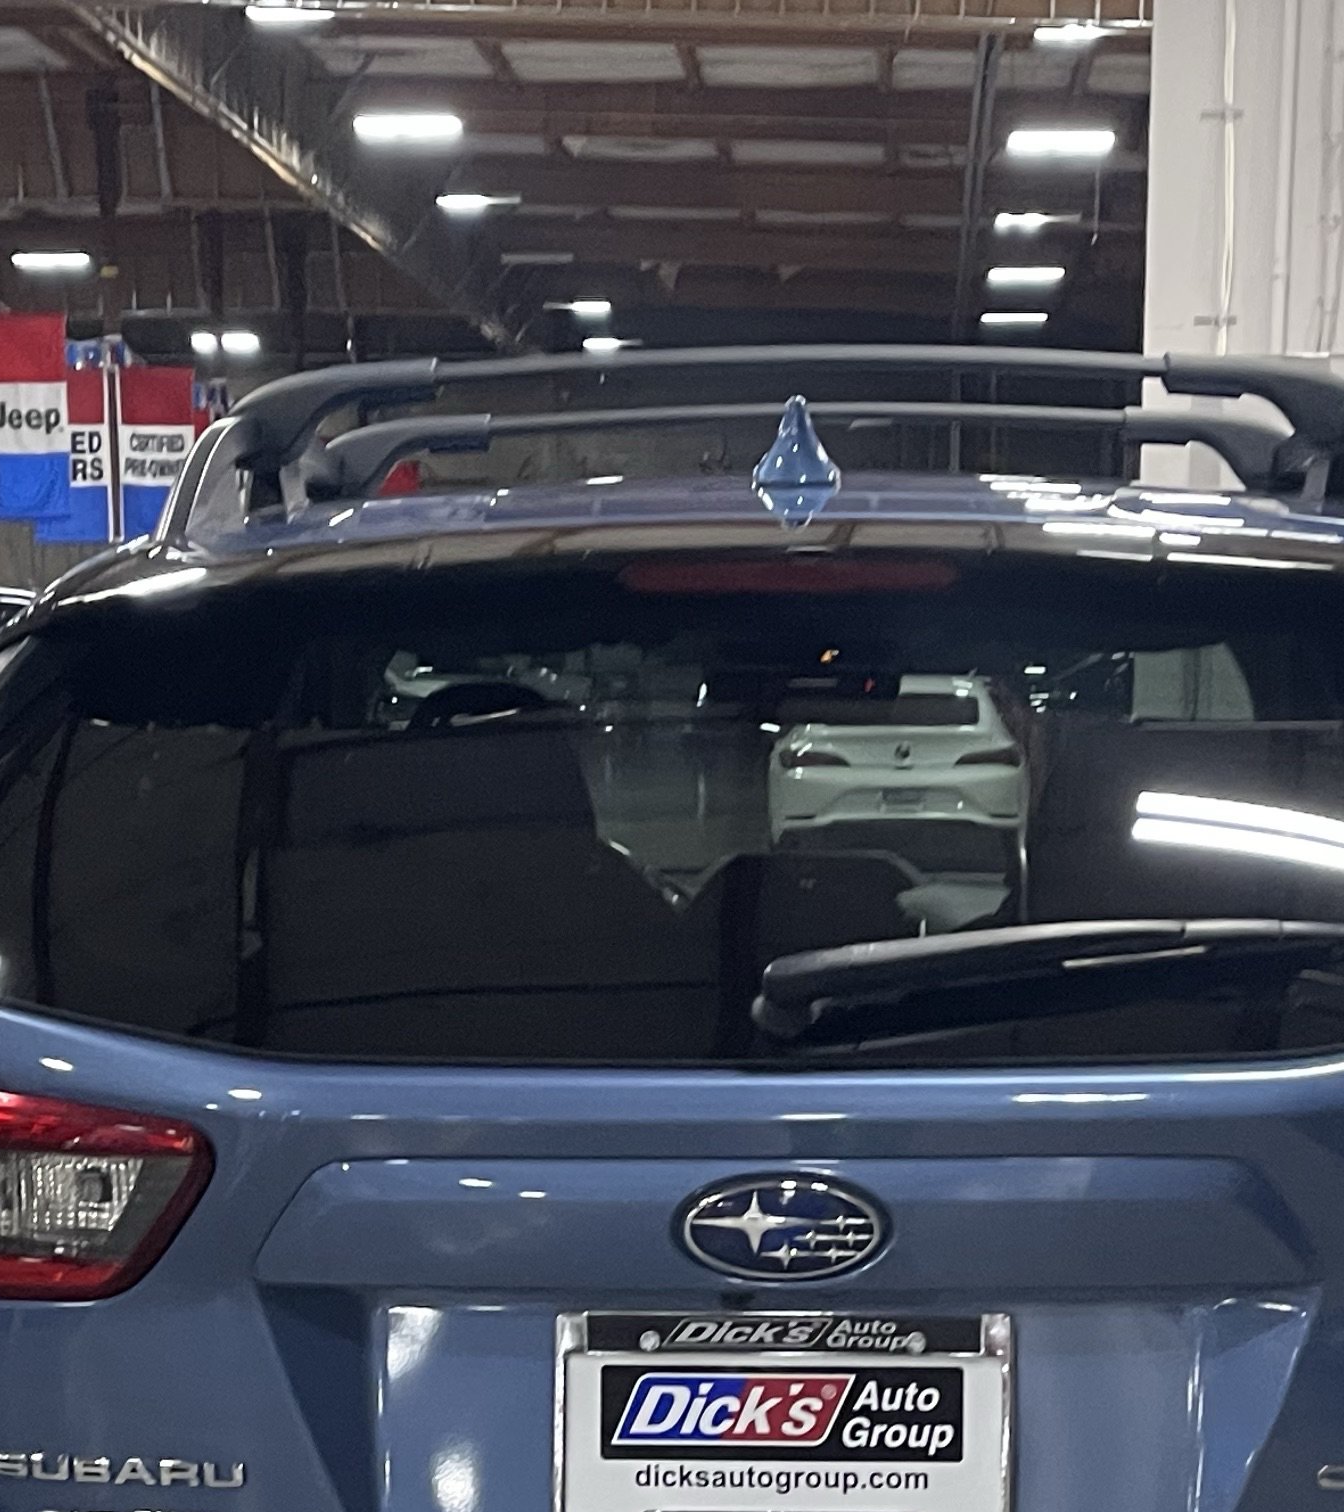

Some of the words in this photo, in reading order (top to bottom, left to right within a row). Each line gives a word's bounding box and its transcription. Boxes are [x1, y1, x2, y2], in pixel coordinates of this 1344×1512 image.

[674, 1320, 824, 1344] Dick's
[832, 1319, 897, 1335] Auto
[629, 1381, 824, 1436] Dick's
[853, 1380, 940, 1412] Auto
[842, 1419, 955, 1456] Group
[635, 1465, 929, 1495] dicksautogroup.com
